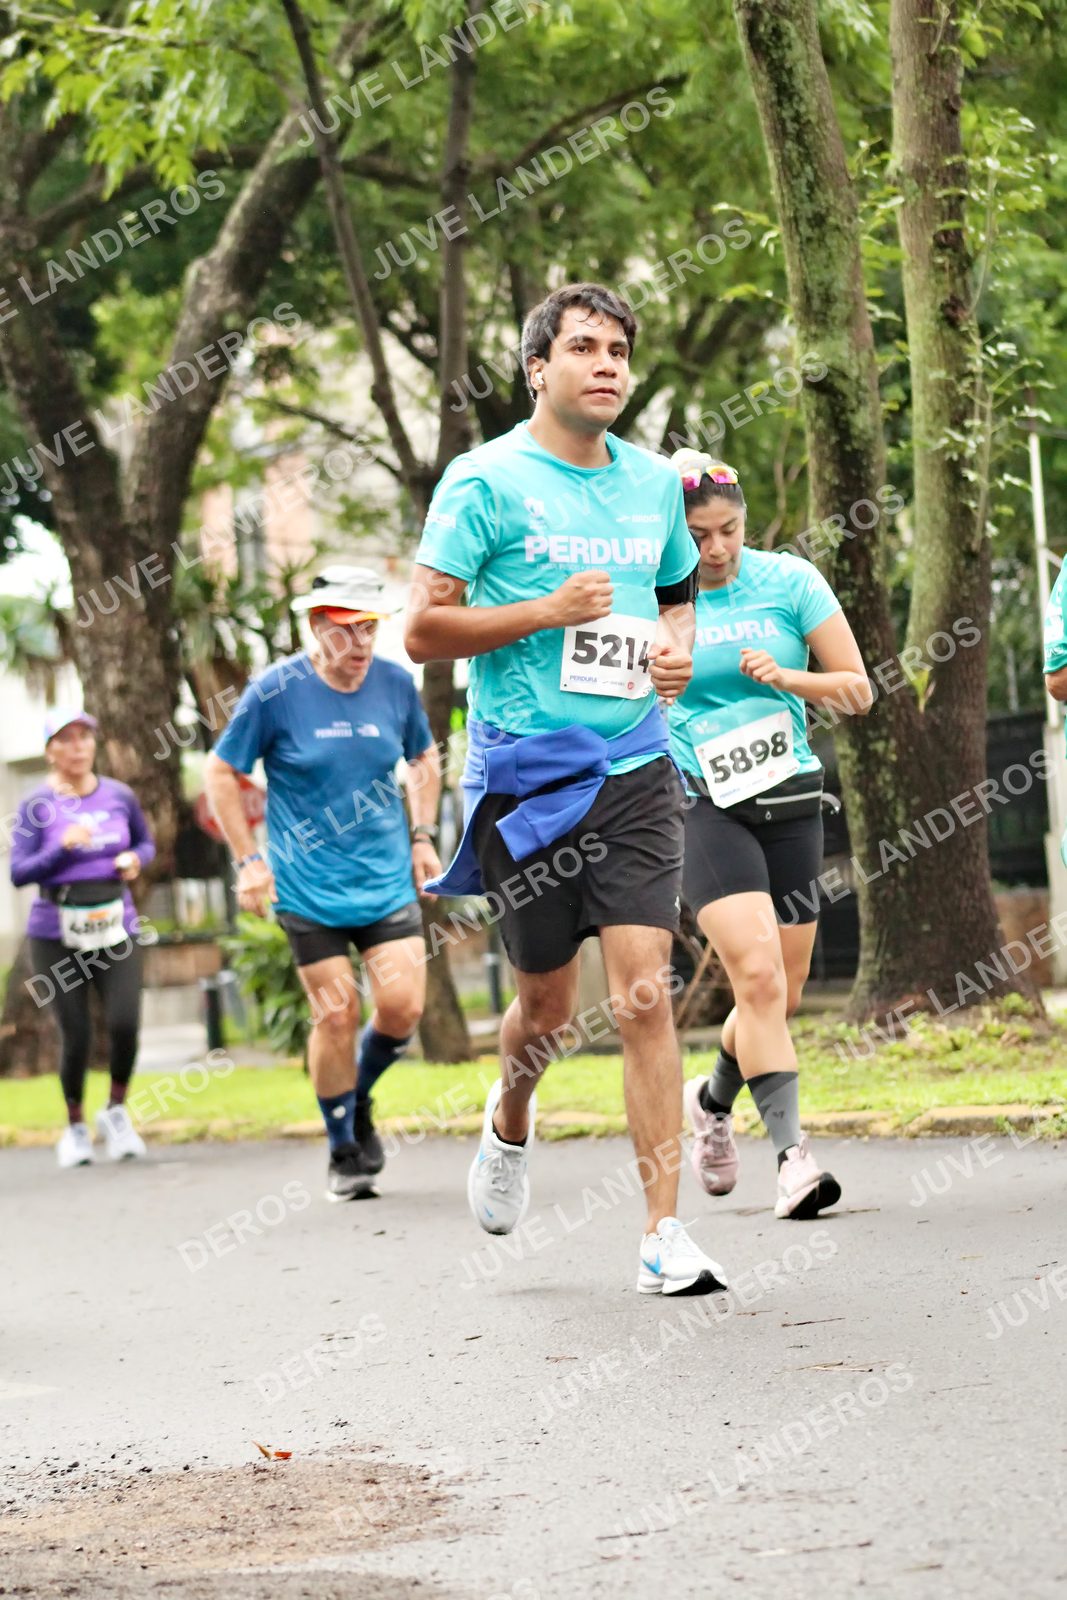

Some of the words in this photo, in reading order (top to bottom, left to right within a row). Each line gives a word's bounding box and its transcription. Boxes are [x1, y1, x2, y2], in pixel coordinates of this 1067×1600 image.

[571, 630, 650, 674] 5214
[695, 617, 780, 647] DURA
[708, 731, 789, 784] 5898
